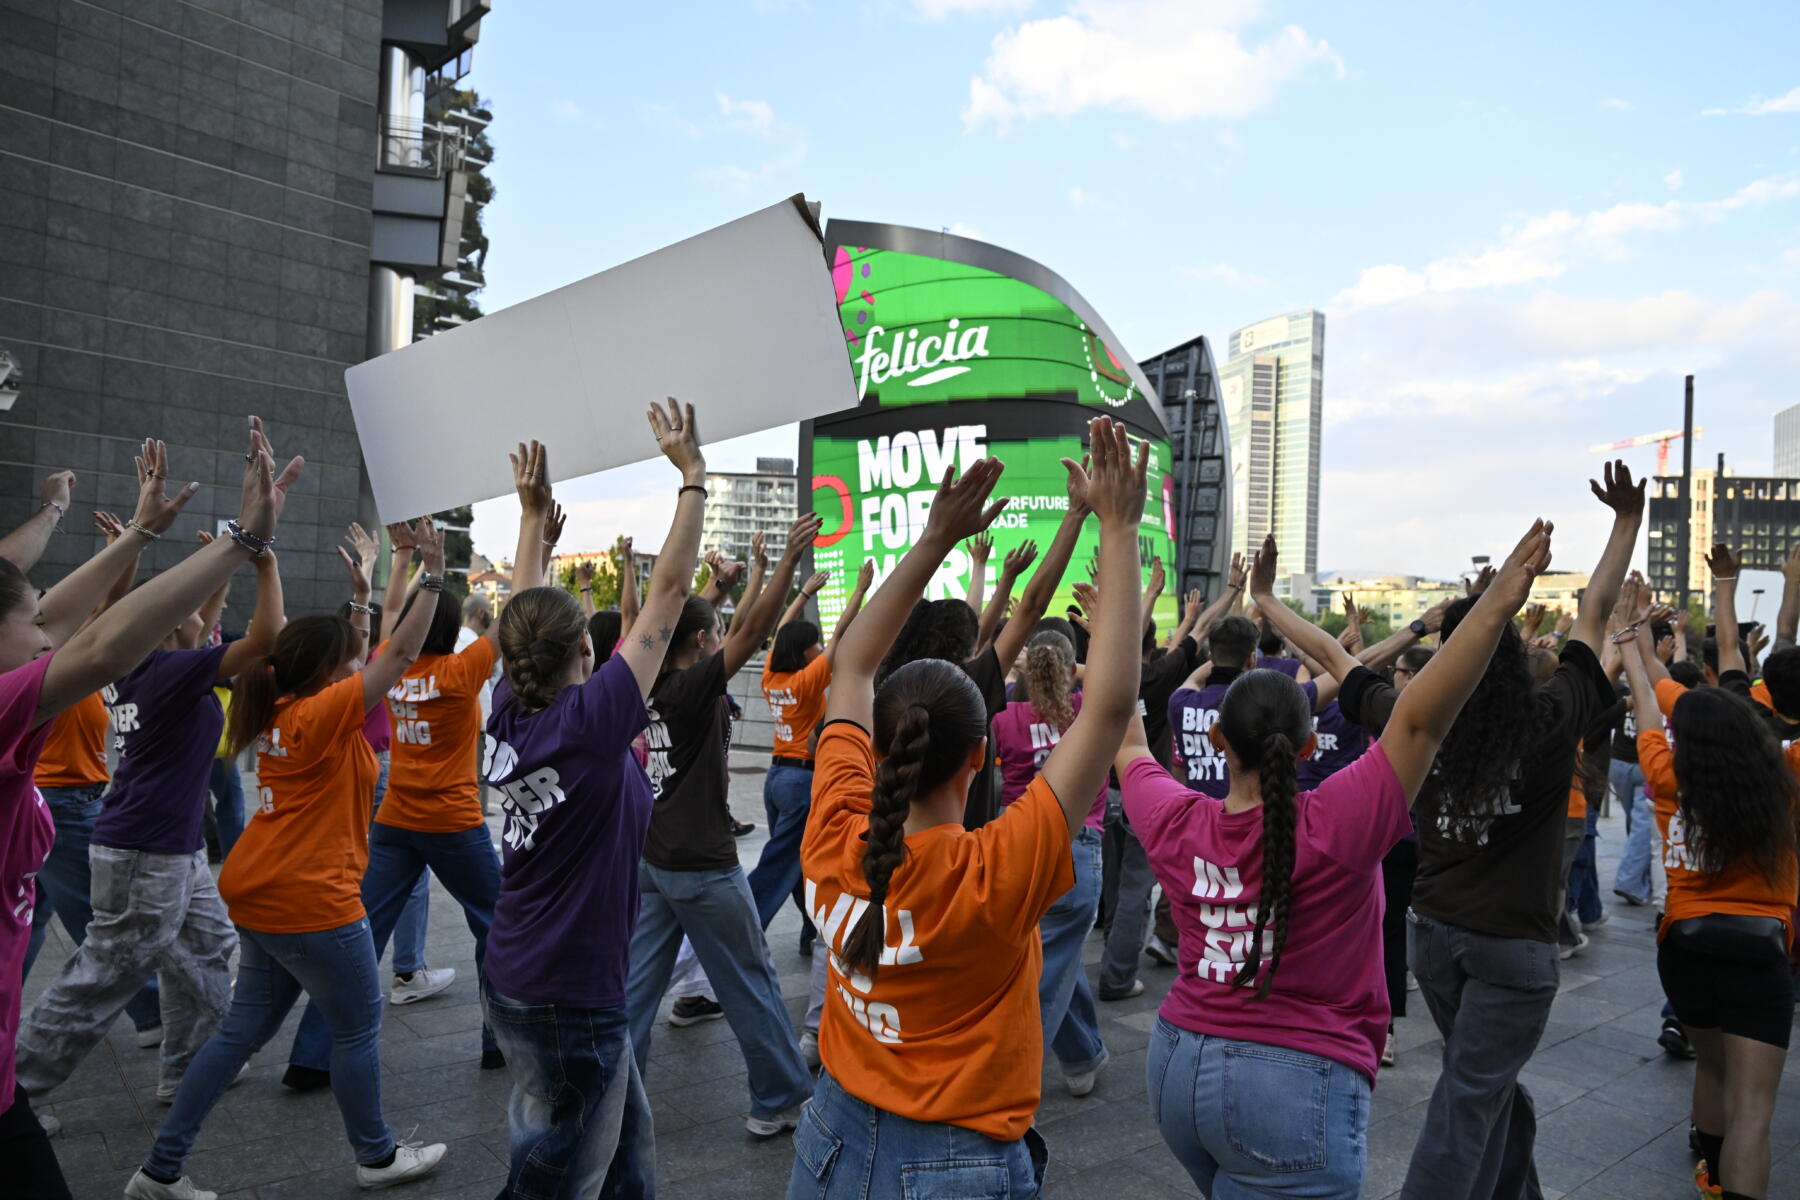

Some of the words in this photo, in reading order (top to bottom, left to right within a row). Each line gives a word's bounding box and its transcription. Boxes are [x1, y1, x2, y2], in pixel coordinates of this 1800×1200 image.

[855, 318, 989, 401] felicia
[857, 424, 987, 493] MOVE
[1029, 723, 1061, 748] IN
[1182, 706, 1220, 733] BIO
[1187, 756, 1227, 780] SITY
[1191, 855, 1244, 899] IN
